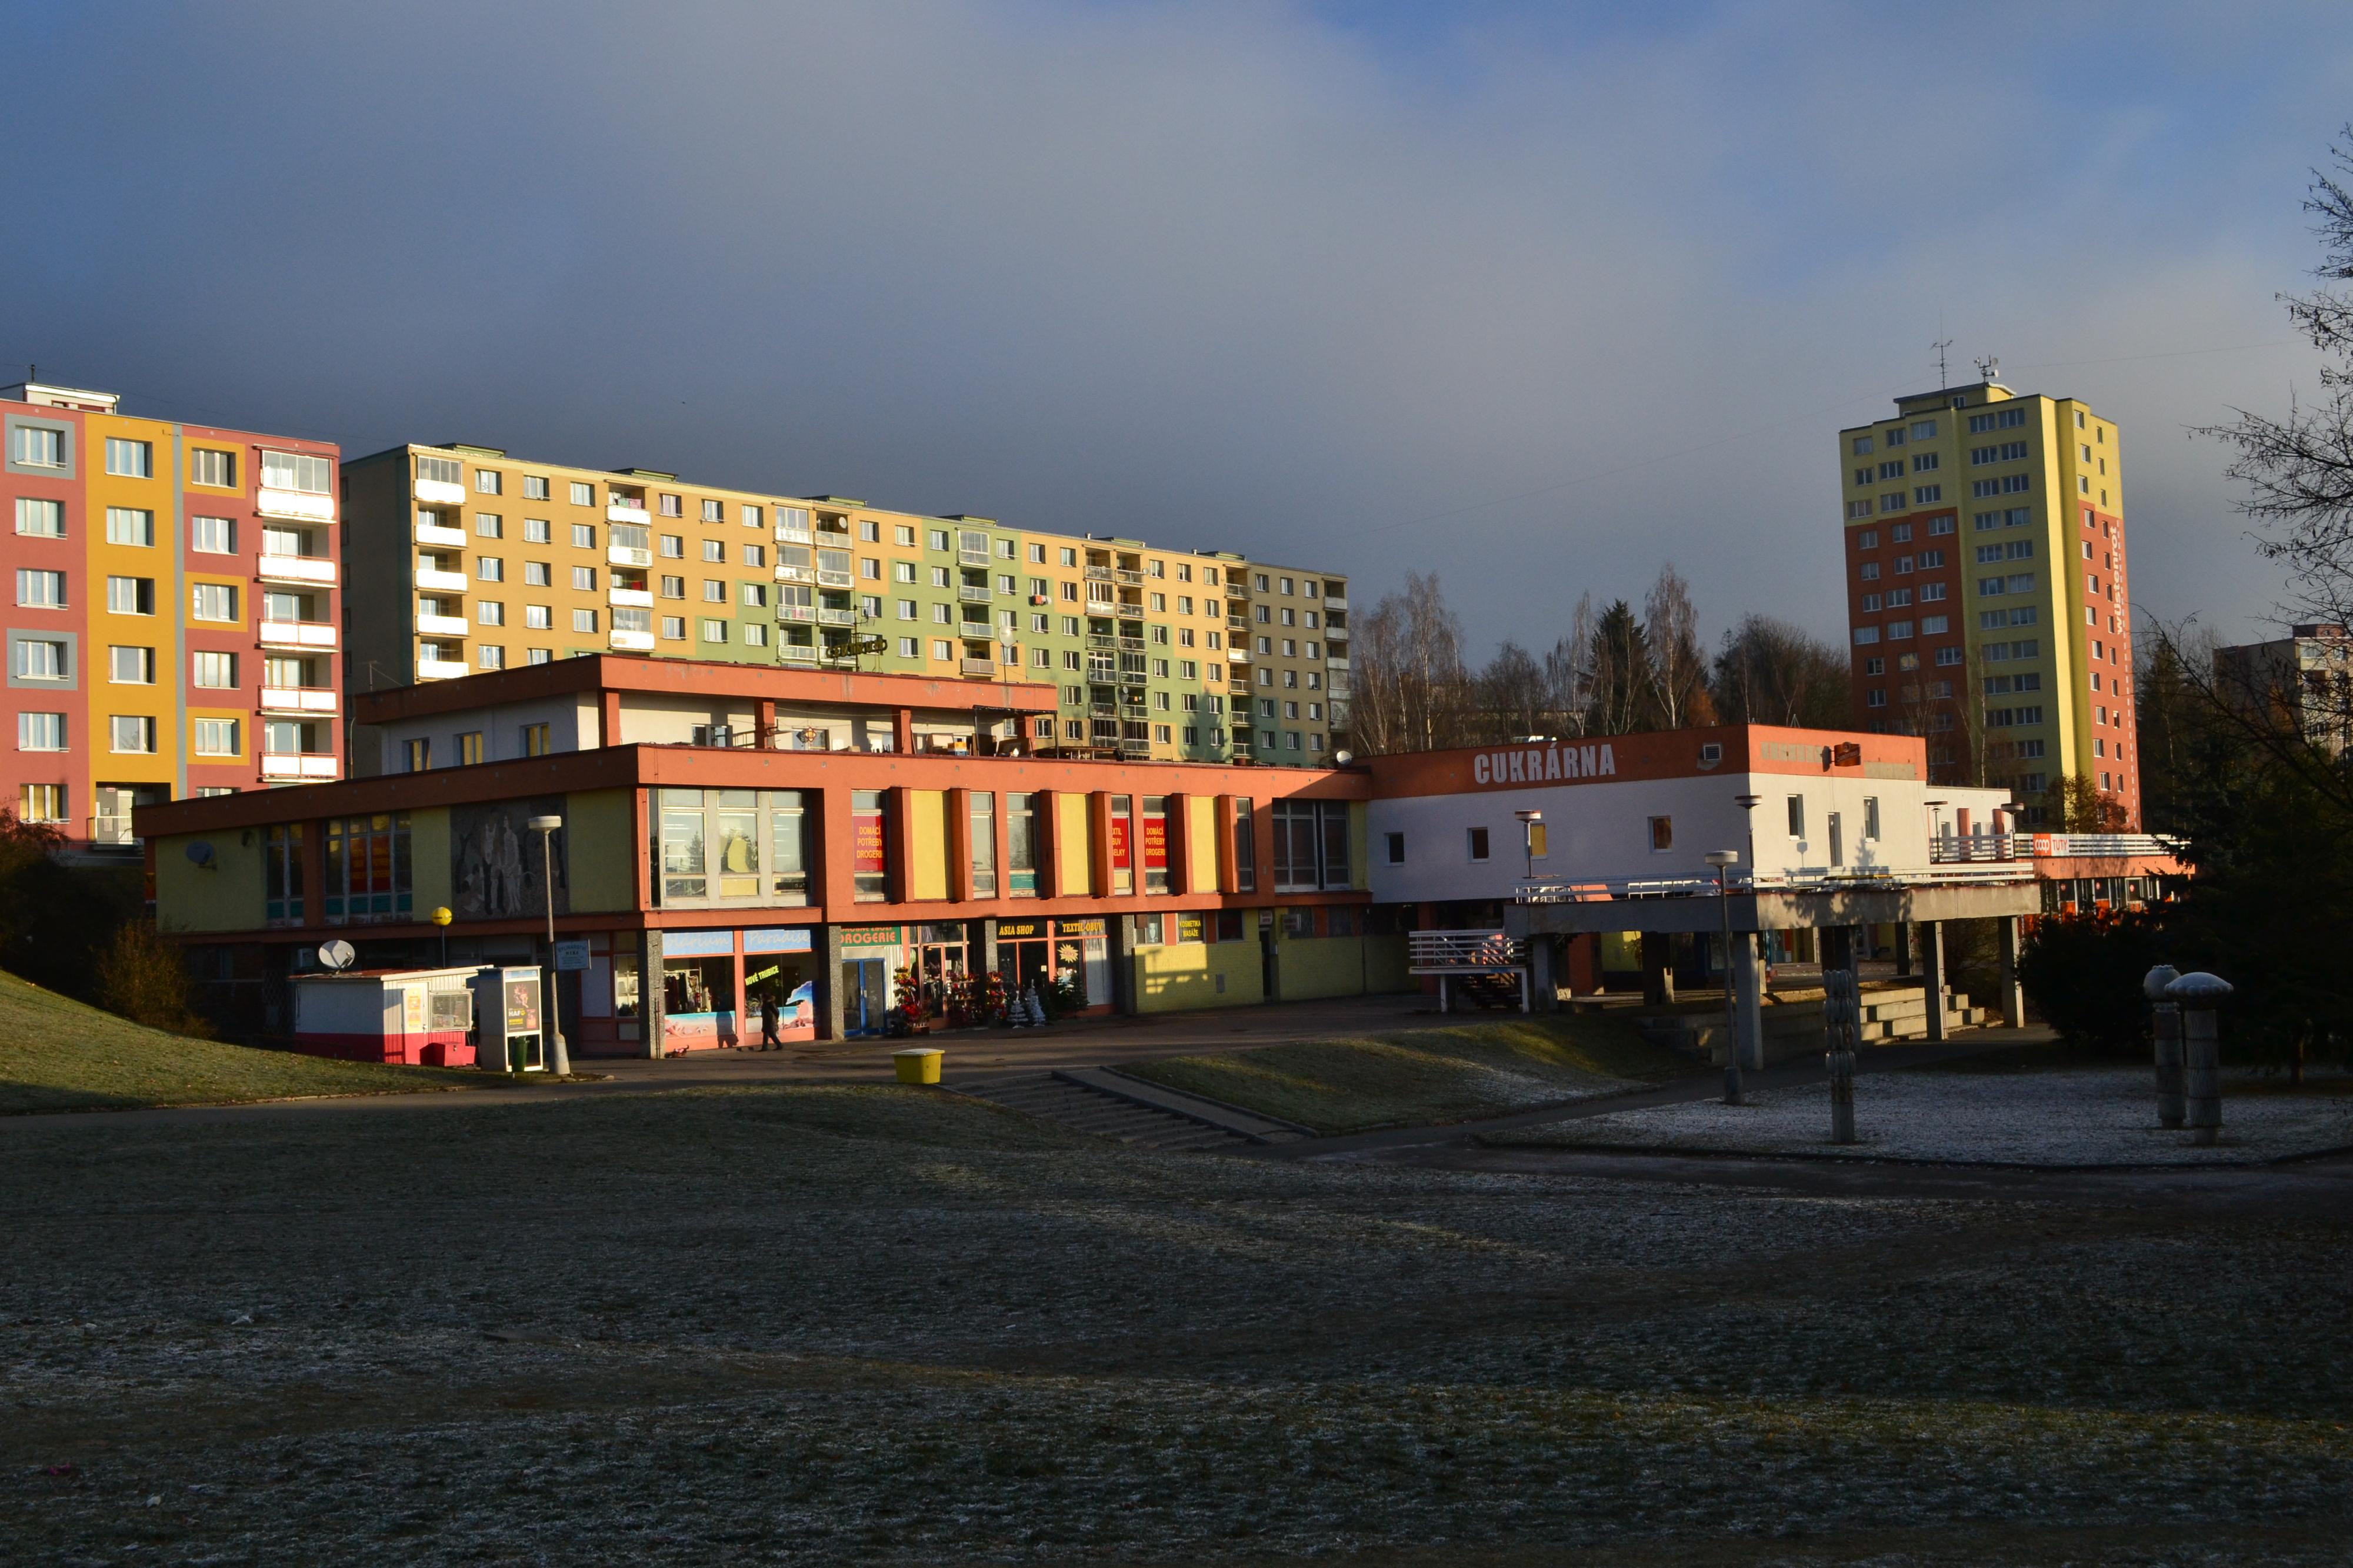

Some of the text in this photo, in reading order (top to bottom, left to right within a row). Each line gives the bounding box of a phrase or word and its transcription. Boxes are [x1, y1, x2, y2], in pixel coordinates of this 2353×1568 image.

[1474, 742, 1615, 784] CUKRÁRNA
[859, 825, 881, 835] DOMÁCÍ
[1146, 826, 1164, 835] DOMÁCÍ
[857, 836, 882, 846] POTŘEBY
[1145, 836, 1165, 845] POTŘEBY
[999, 925, 1034, 936] ASIA SHOP
